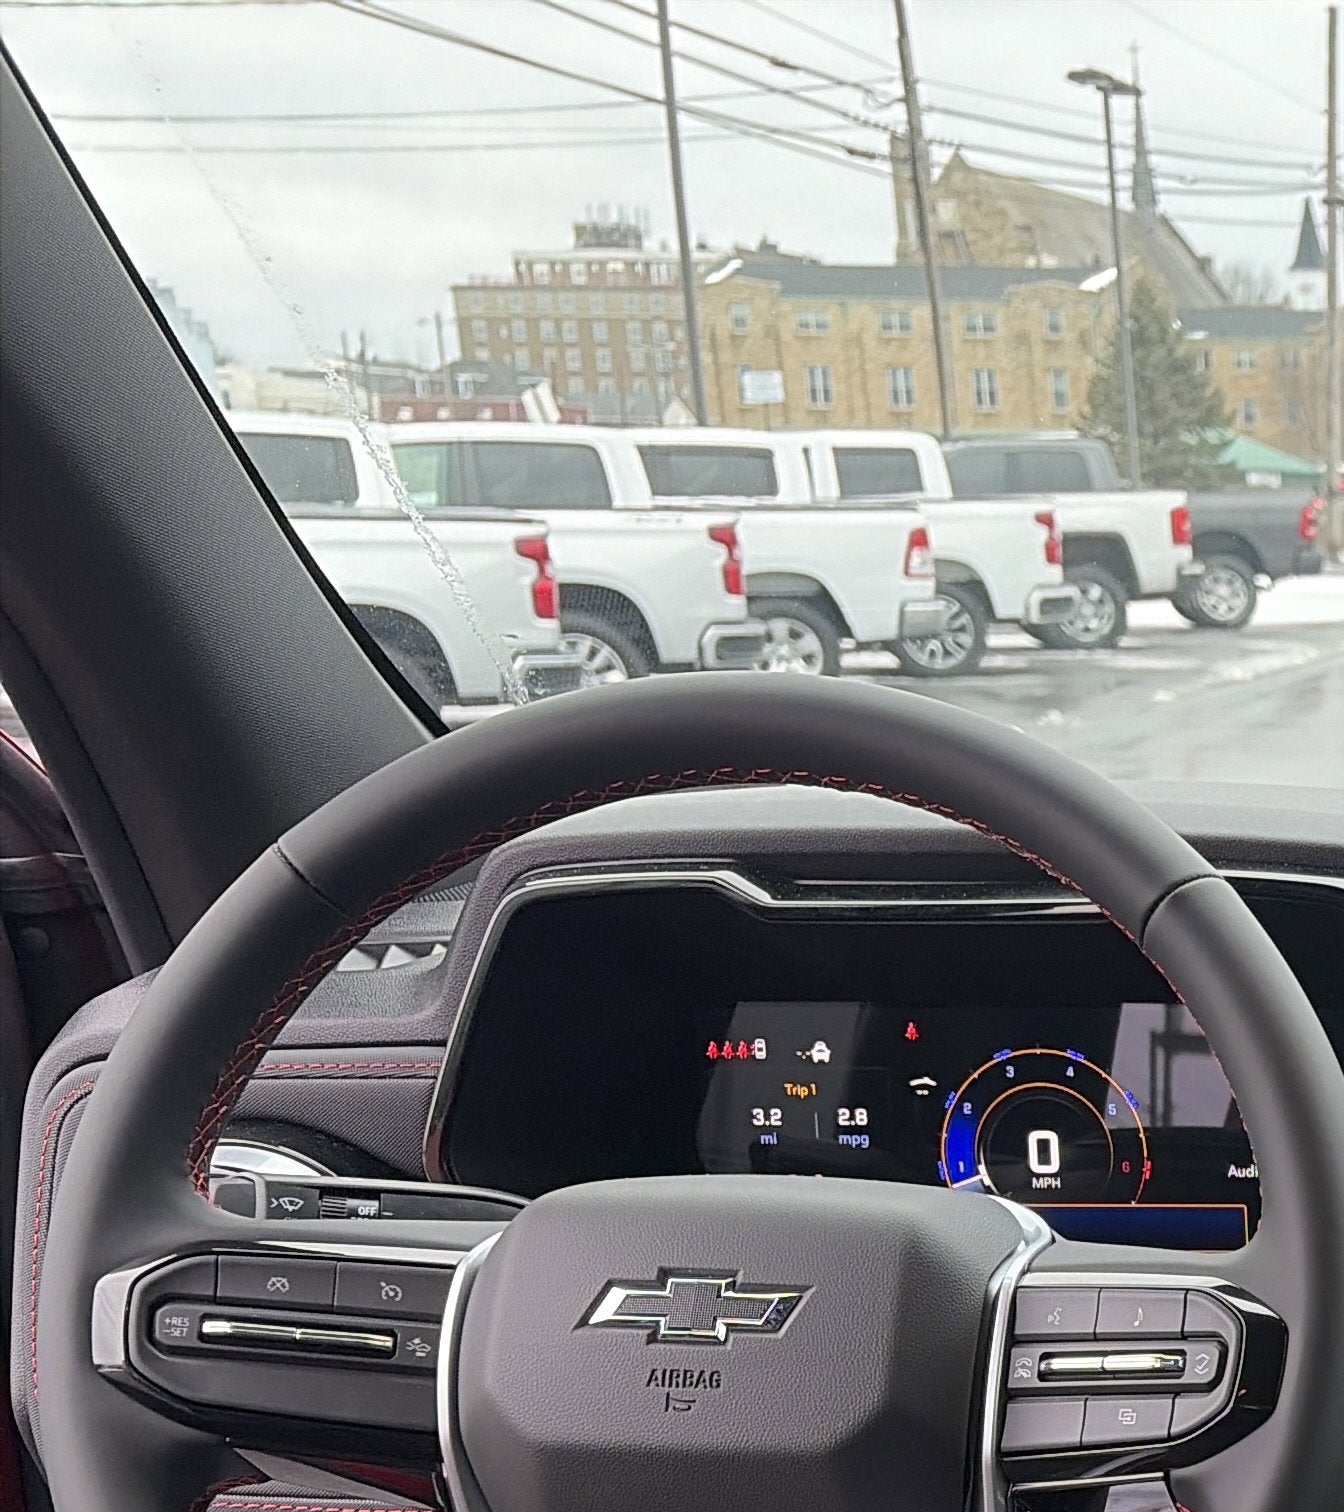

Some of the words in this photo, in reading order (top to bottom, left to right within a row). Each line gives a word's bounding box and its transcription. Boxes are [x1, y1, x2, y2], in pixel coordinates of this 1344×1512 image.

[1005, 1065, 1015, 1079] 3
[1065, 1065, 1075, 1079] 4
[783, 1083, 809, 1100] Trip
[811, 1083, 818, 1096] 1
[963, 1101, 972, 1115] 2
[1107, 1103, 1117, 1116] 5
[752, 1107, 783, 1127] 3.2
[836, 1107, 869, 1127] 2.8
[760, 1131, 778, 1146] mi
[838, 1133, 870, 1149] mpg
[1027, 1130, 1061, 1175] 0
[1031, 1176, 1062, 1190] MPH
[357, 1206, 378, 1217] OFF
[646, 1368, 722, 1390] AIRBAG
